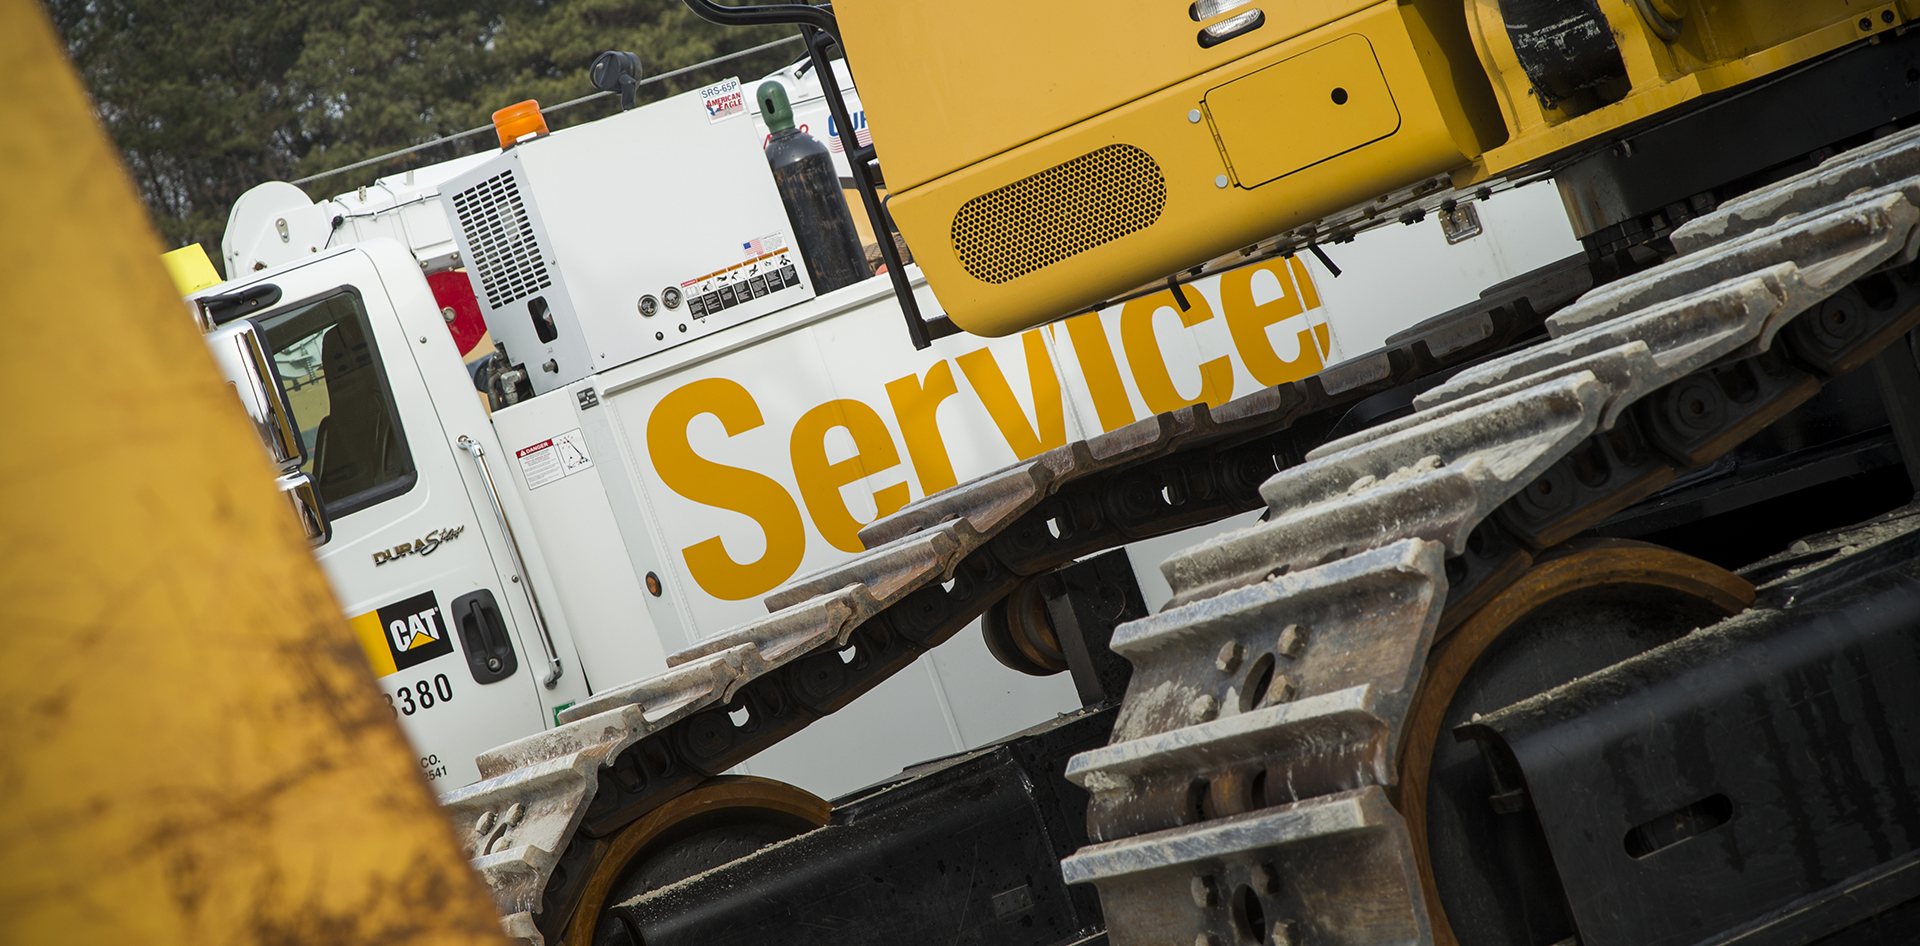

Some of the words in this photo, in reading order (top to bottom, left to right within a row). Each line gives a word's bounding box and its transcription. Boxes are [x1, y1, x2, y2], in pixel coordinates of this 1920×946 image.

[701, 81, 737, 99] SRS-65P
[706, 92, 741, 108] AMERICAN
[718, 99, 743, 111] EAGLE
[646, 254, 1331, 602] Service
[525, 442, 549, 454] DANGER
[390, 607, 440, 652] CAT
[421, 754, 441, 768] CO.
